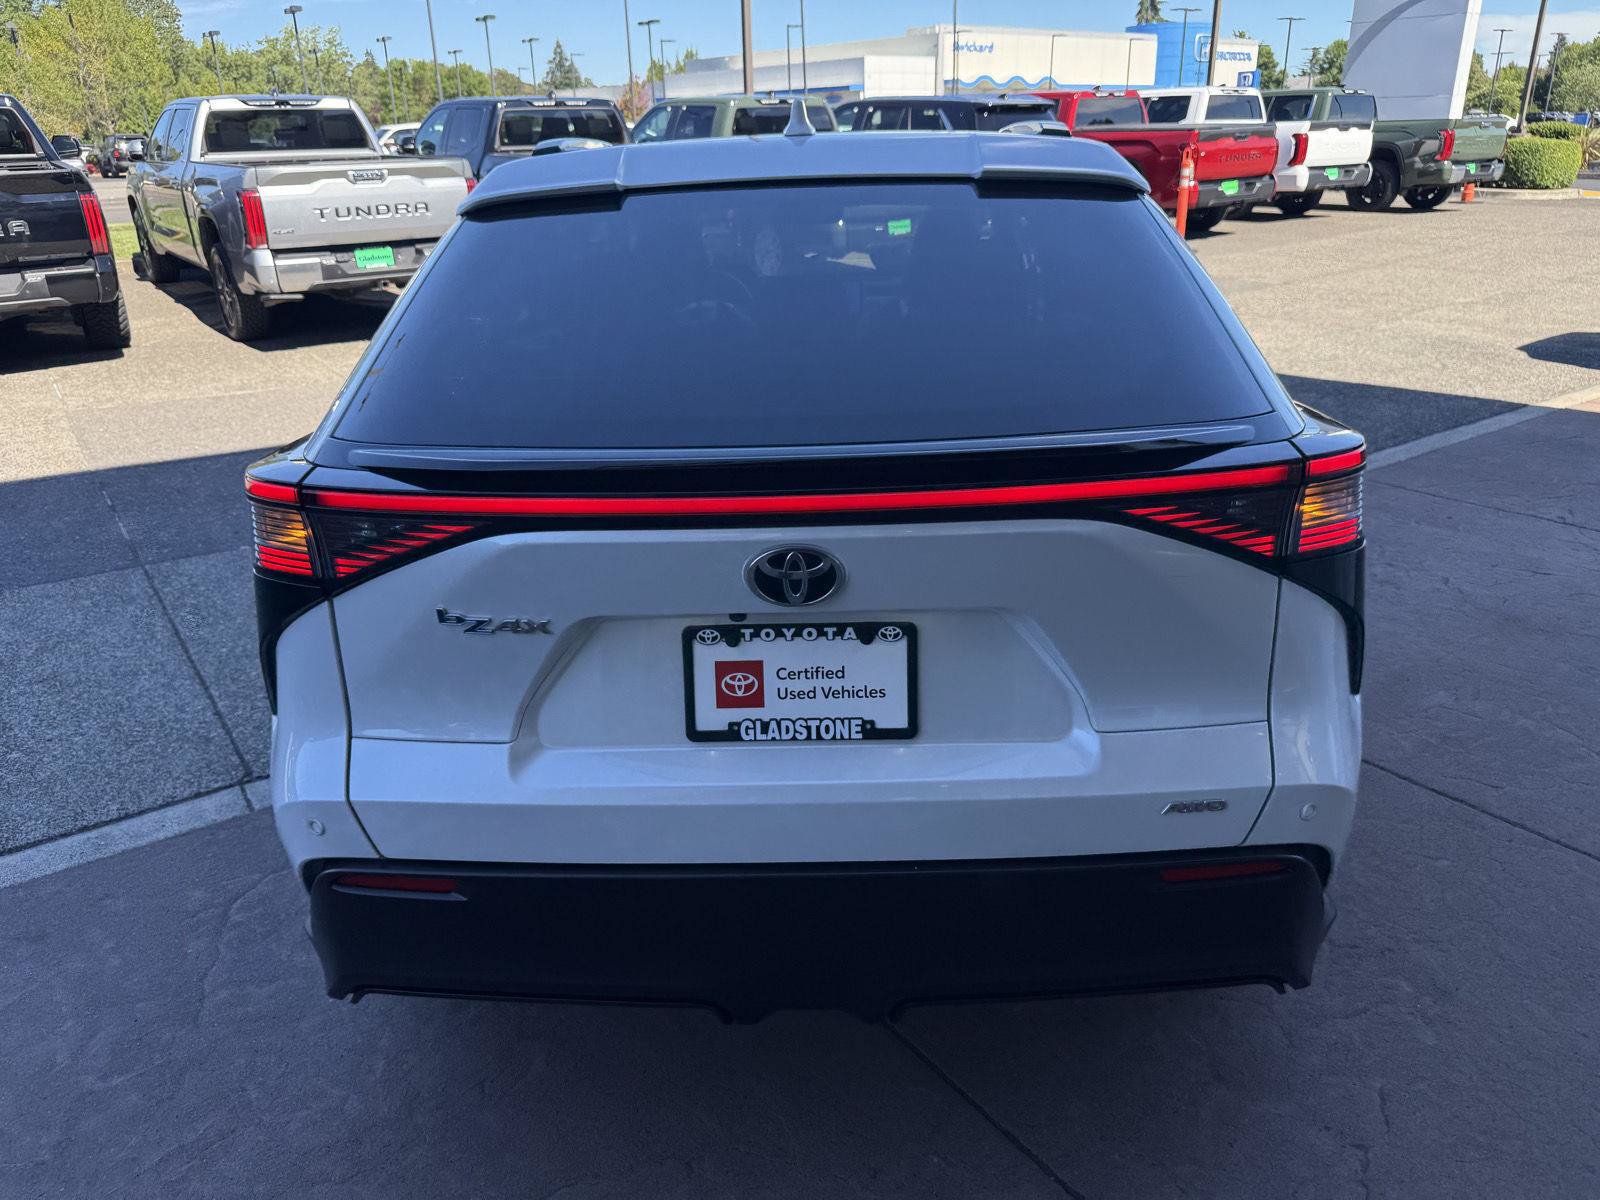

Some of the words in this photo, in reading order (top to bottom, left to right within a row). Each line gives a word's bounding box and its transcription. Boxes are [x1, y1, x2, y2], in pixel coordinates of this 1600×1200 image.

[313, 202, 432, 222] TUNDRA
[741, 627, 858, 641] TOYOTA
[776, 666, 845, 681] Certified
[777, 686, 817, 700] Used
[821, 685, 886, 699] Vehicles
[740, 718, 863, 741] GLADSTONE
[1160, 799, 1228, 815] AWD
